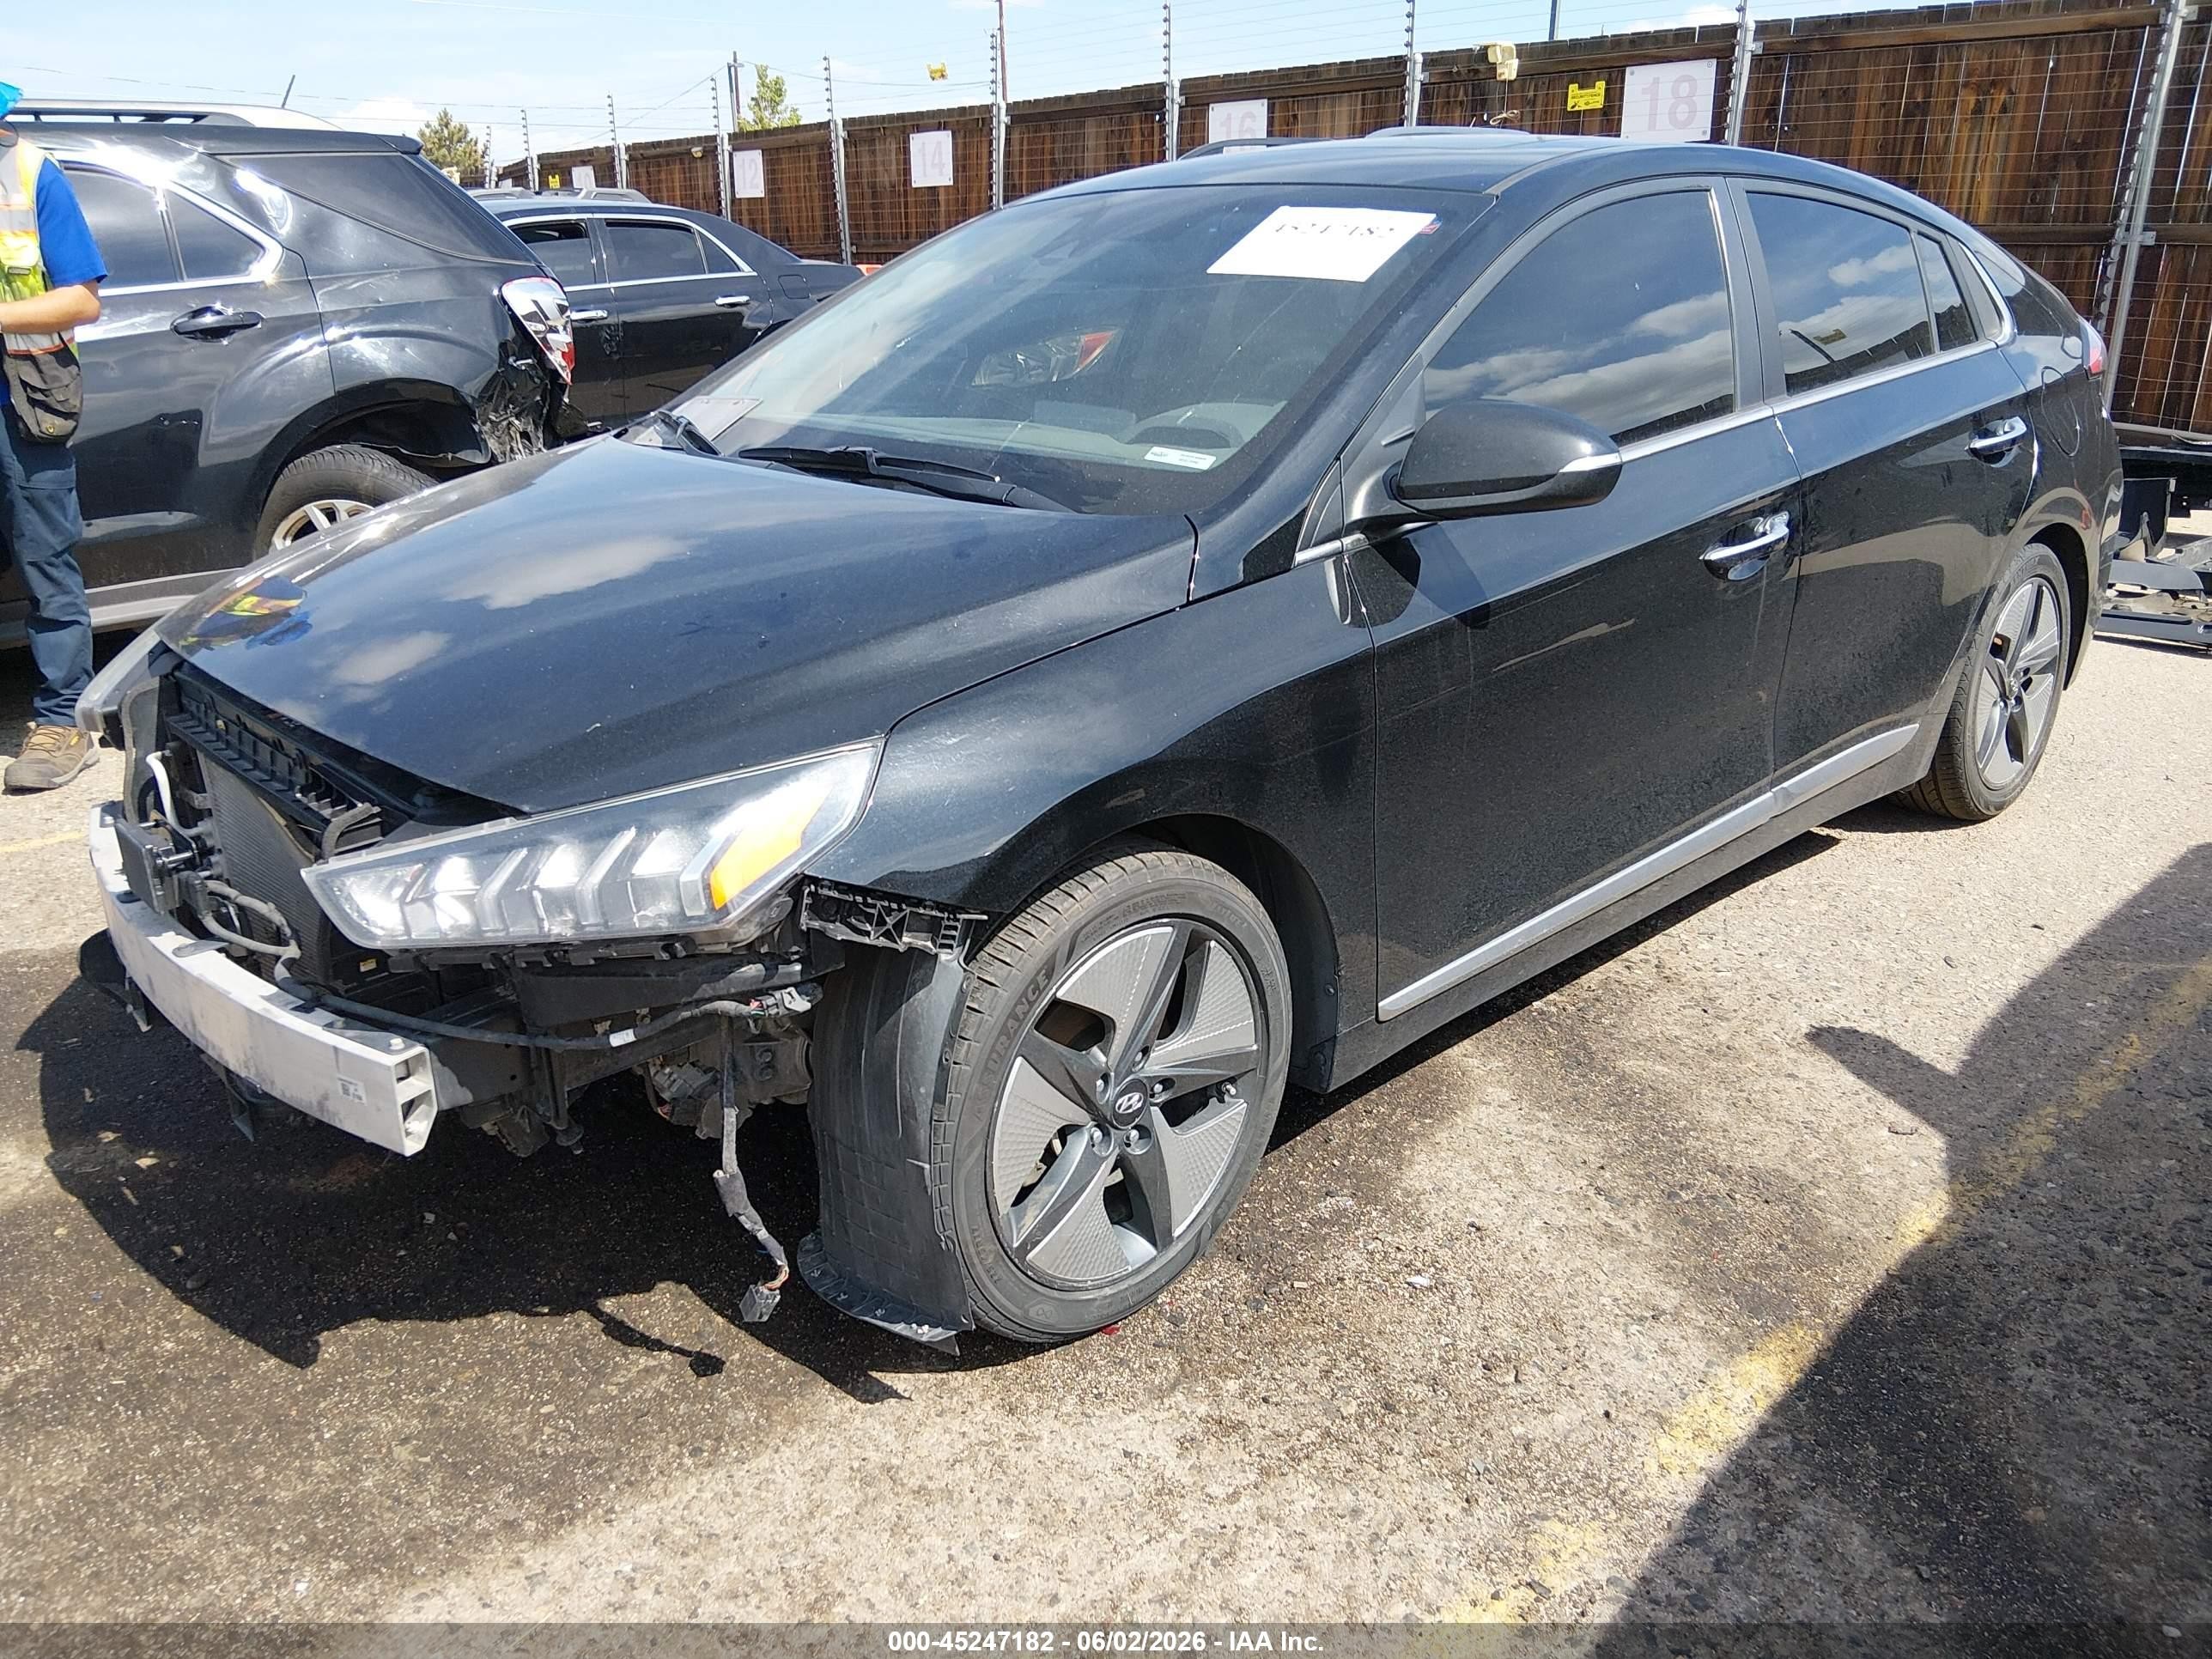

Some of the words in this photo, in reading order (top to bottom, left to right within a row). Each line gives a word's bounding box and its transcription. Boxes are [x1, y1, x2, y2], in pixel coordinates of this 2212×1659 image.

[1641, 74, 1698, 131] 18
[1219, 110, 1257, 138] 16
[738, 157, 760, 189] 12
[918, 141, 946, 177] 14
